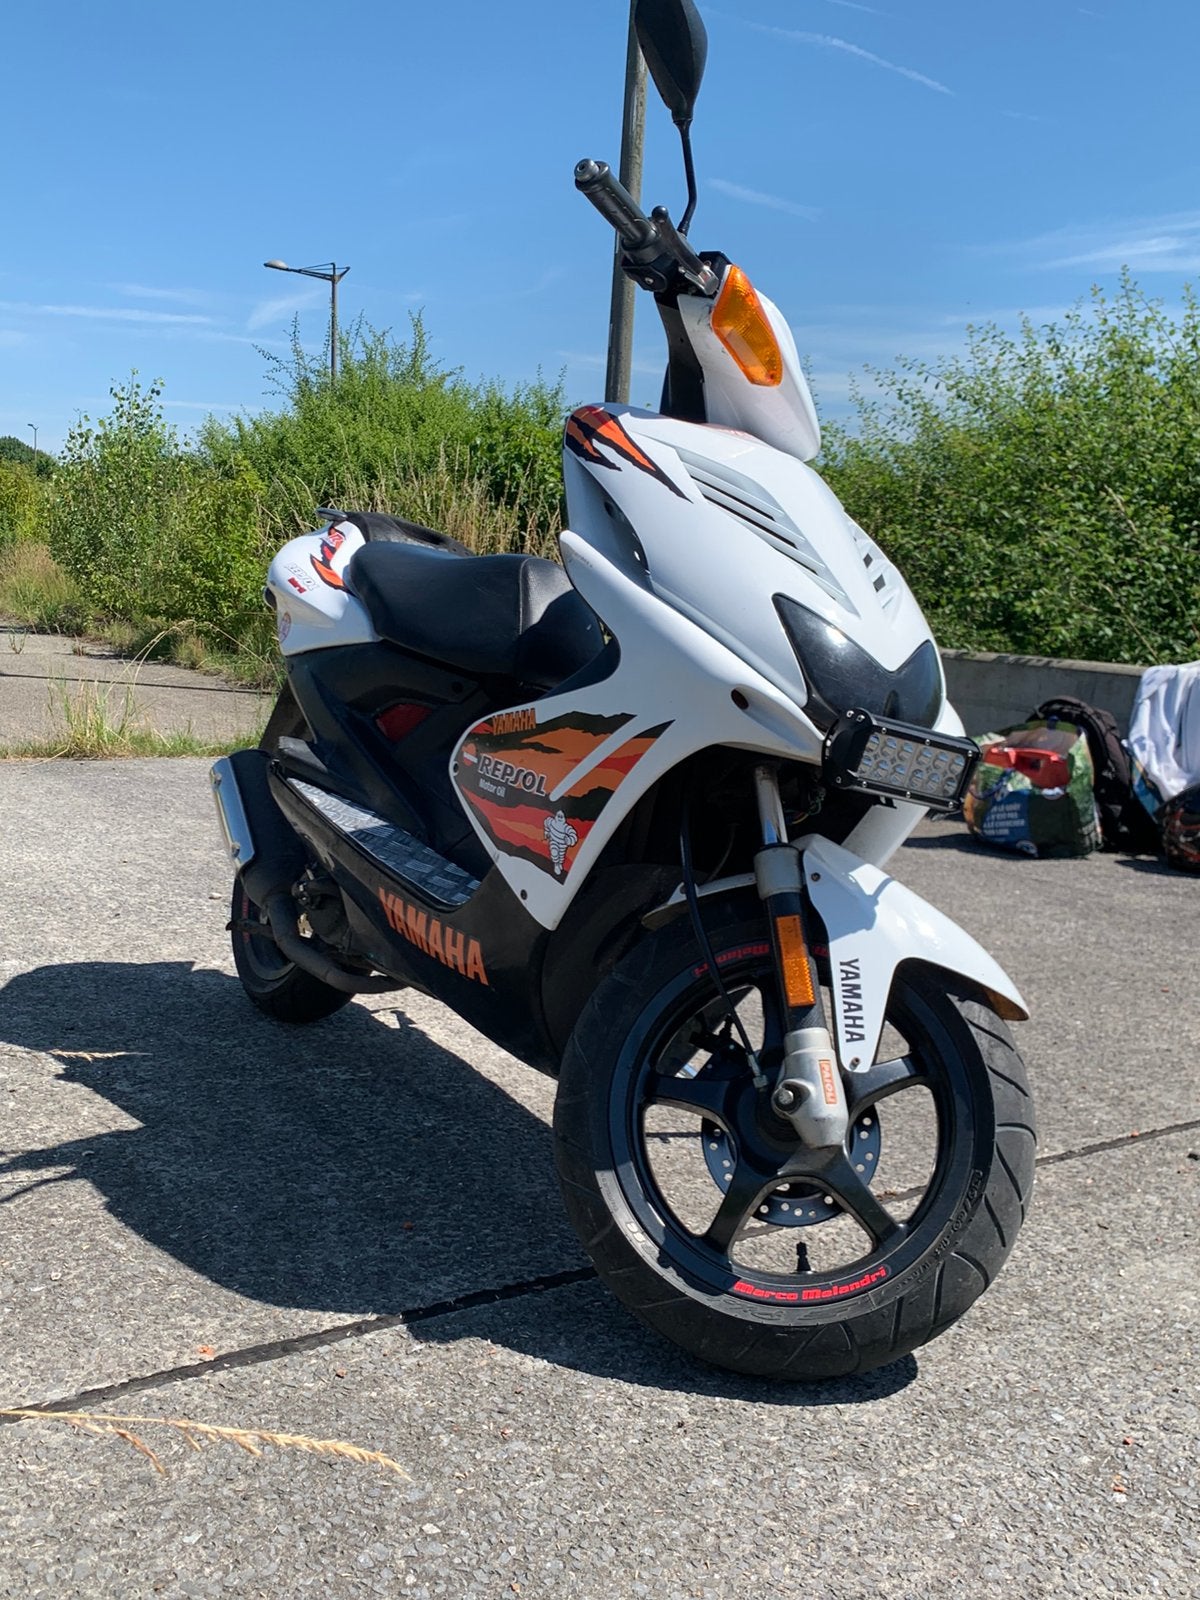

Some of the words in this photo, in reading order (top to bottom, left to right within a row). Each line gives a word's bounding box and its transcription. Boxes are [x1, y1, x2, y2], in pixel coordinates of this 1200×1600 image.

[492, 708, 536, 735] YAMAHA
[478, 753, 547, 797] REPSOL
[479, 780, 497, 794] Motor
[496, 785, 506, 798] Oil
[378, 886, 489, 986] YAMAHA
[839, 958, 866, 1043] YAMAHA
[733, 1281, 798, 1301] Marco
